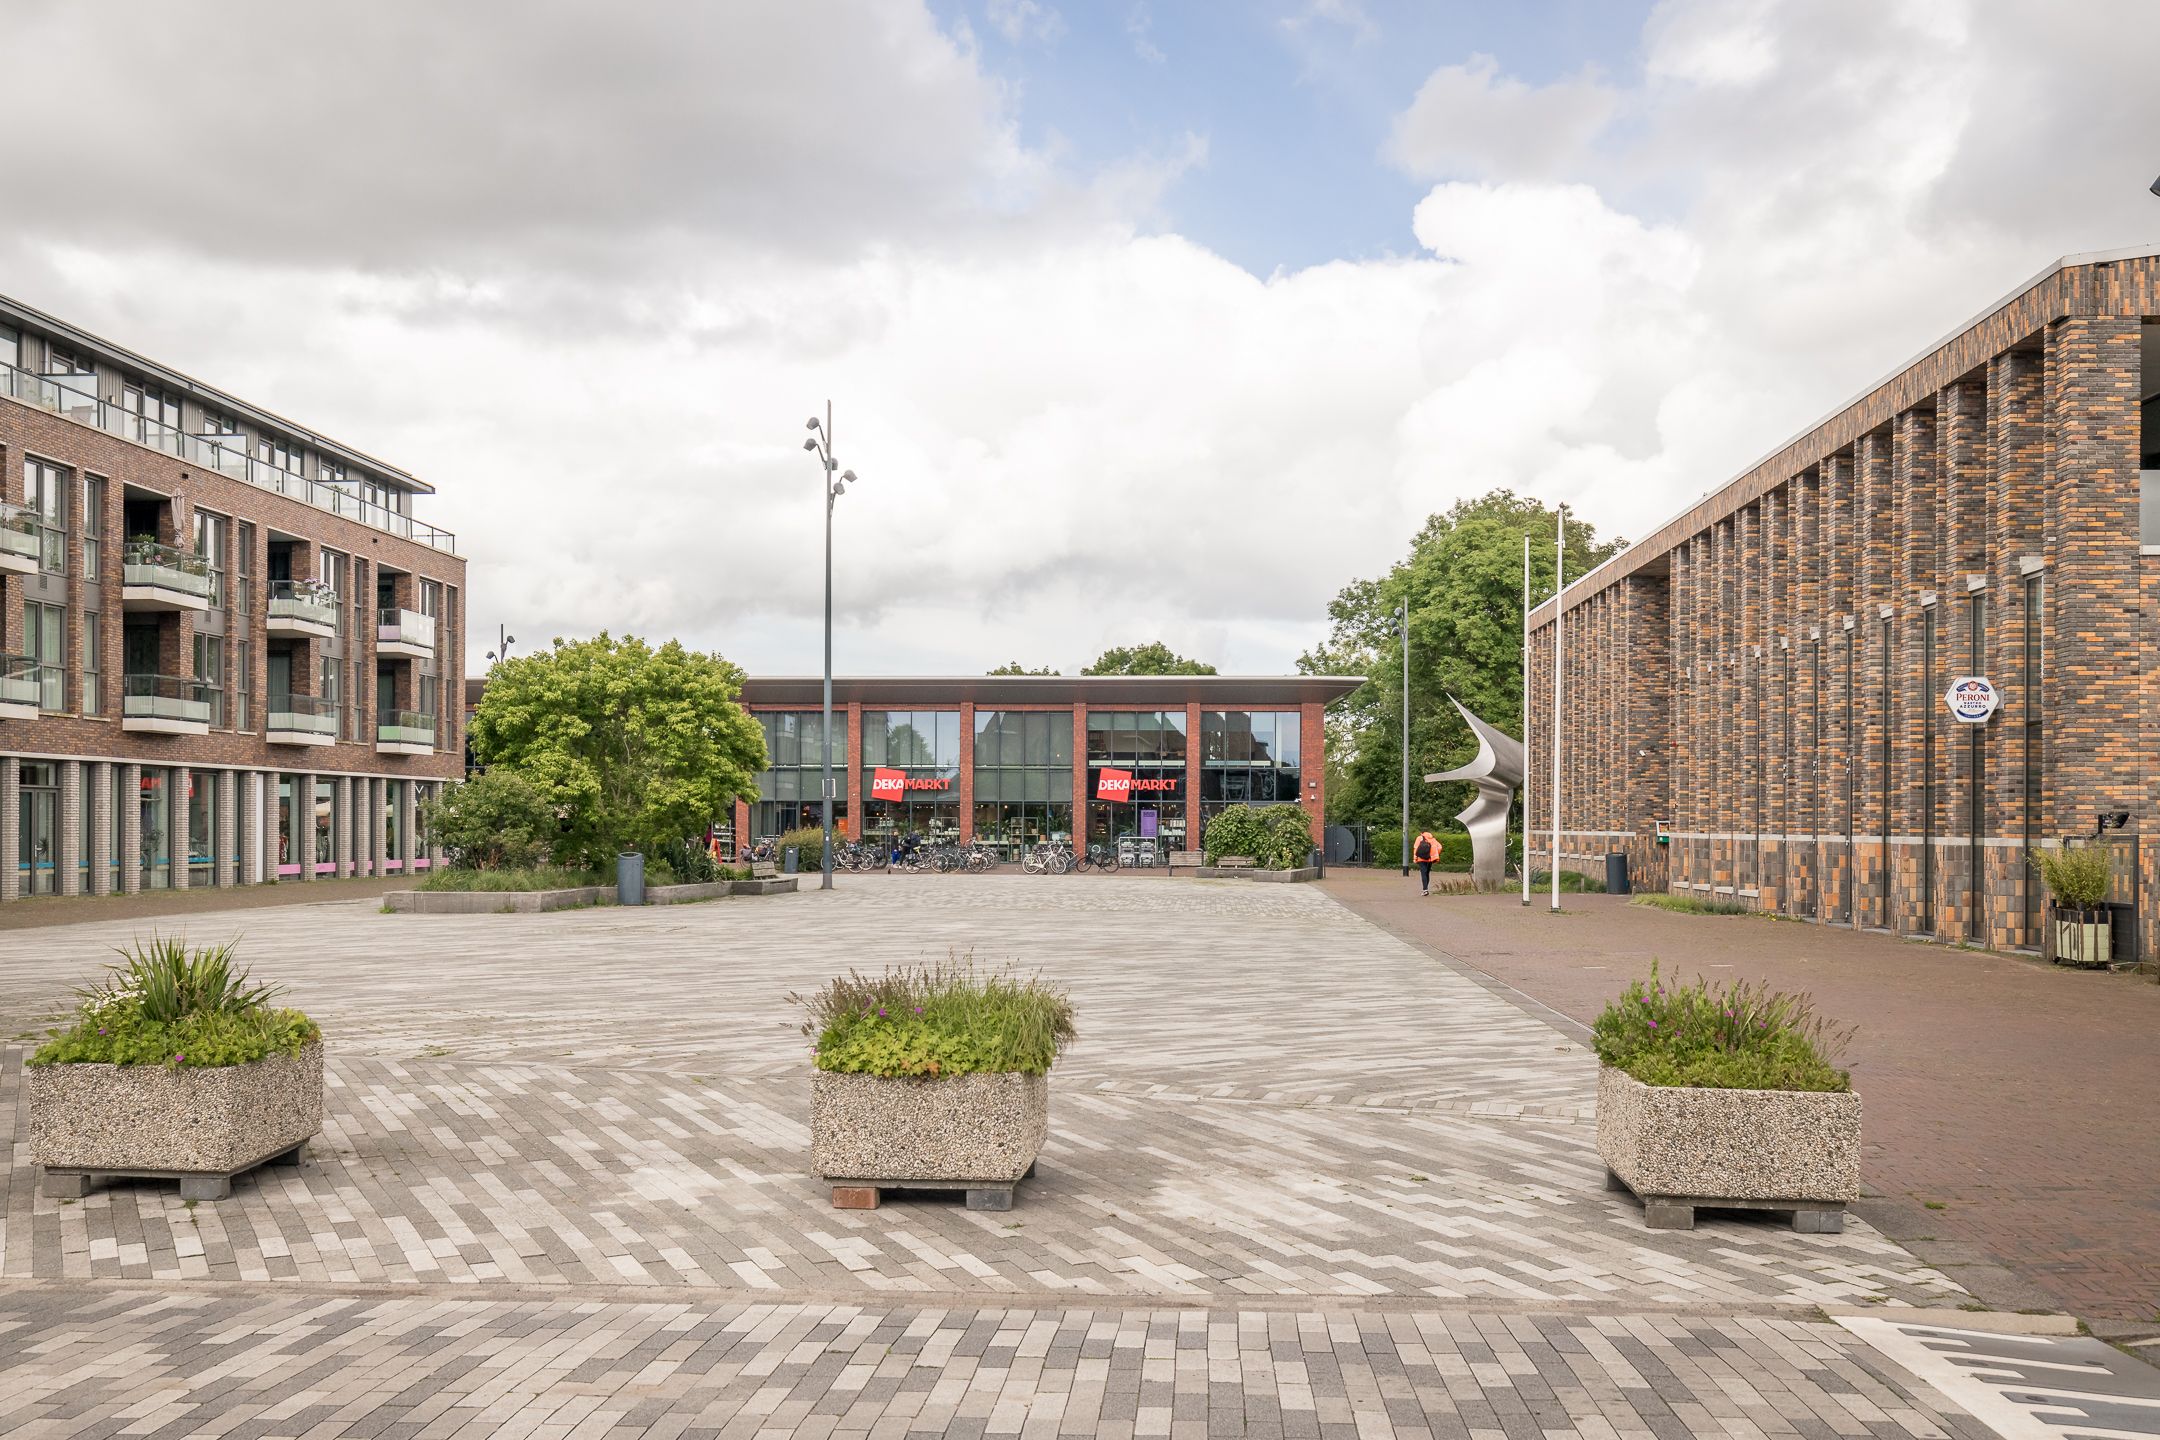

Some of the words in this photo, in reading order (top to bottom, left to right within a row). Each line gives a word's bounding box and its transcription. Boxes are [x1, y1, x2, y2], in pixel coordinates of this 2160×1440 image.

[1956, 693, 1990, 701] PERONI
[873, 778, 951, 790] DEKAMARKT
[1098, 779, 1177, 791] DEKAMARKT
